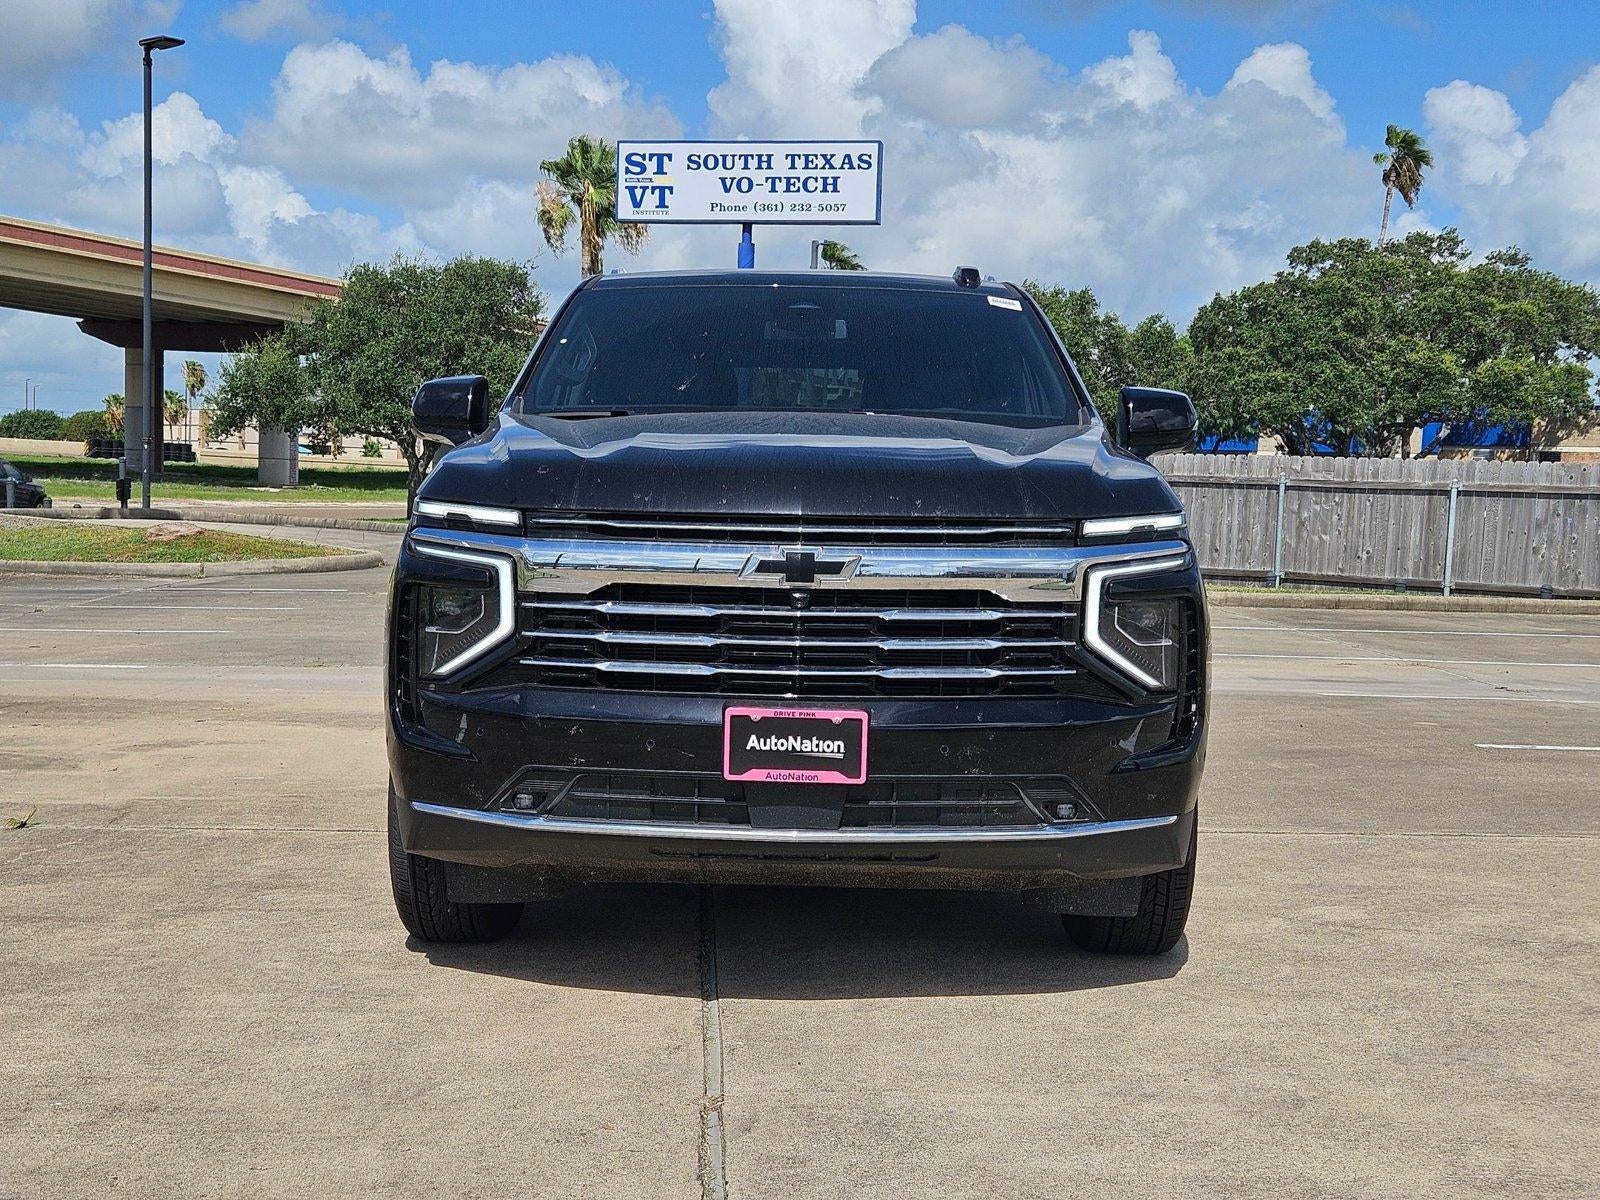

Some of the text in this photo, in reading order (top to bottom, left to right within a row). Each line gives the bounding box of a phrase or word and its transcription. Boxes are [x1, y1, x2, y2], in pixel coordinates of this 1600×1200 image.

[625, 152, 672, 175] ST
[686, 153, 873, 170] SOUTH TEXAS
[719, 176, 841, 194] VO-TECH
[625, 185, 673, 208] VT
[709, 201, 847, 213] Phone (361) 232-5057
[745, 734, 845, 753] AutoNation
[765, 772, 819, 781] AutoNation
